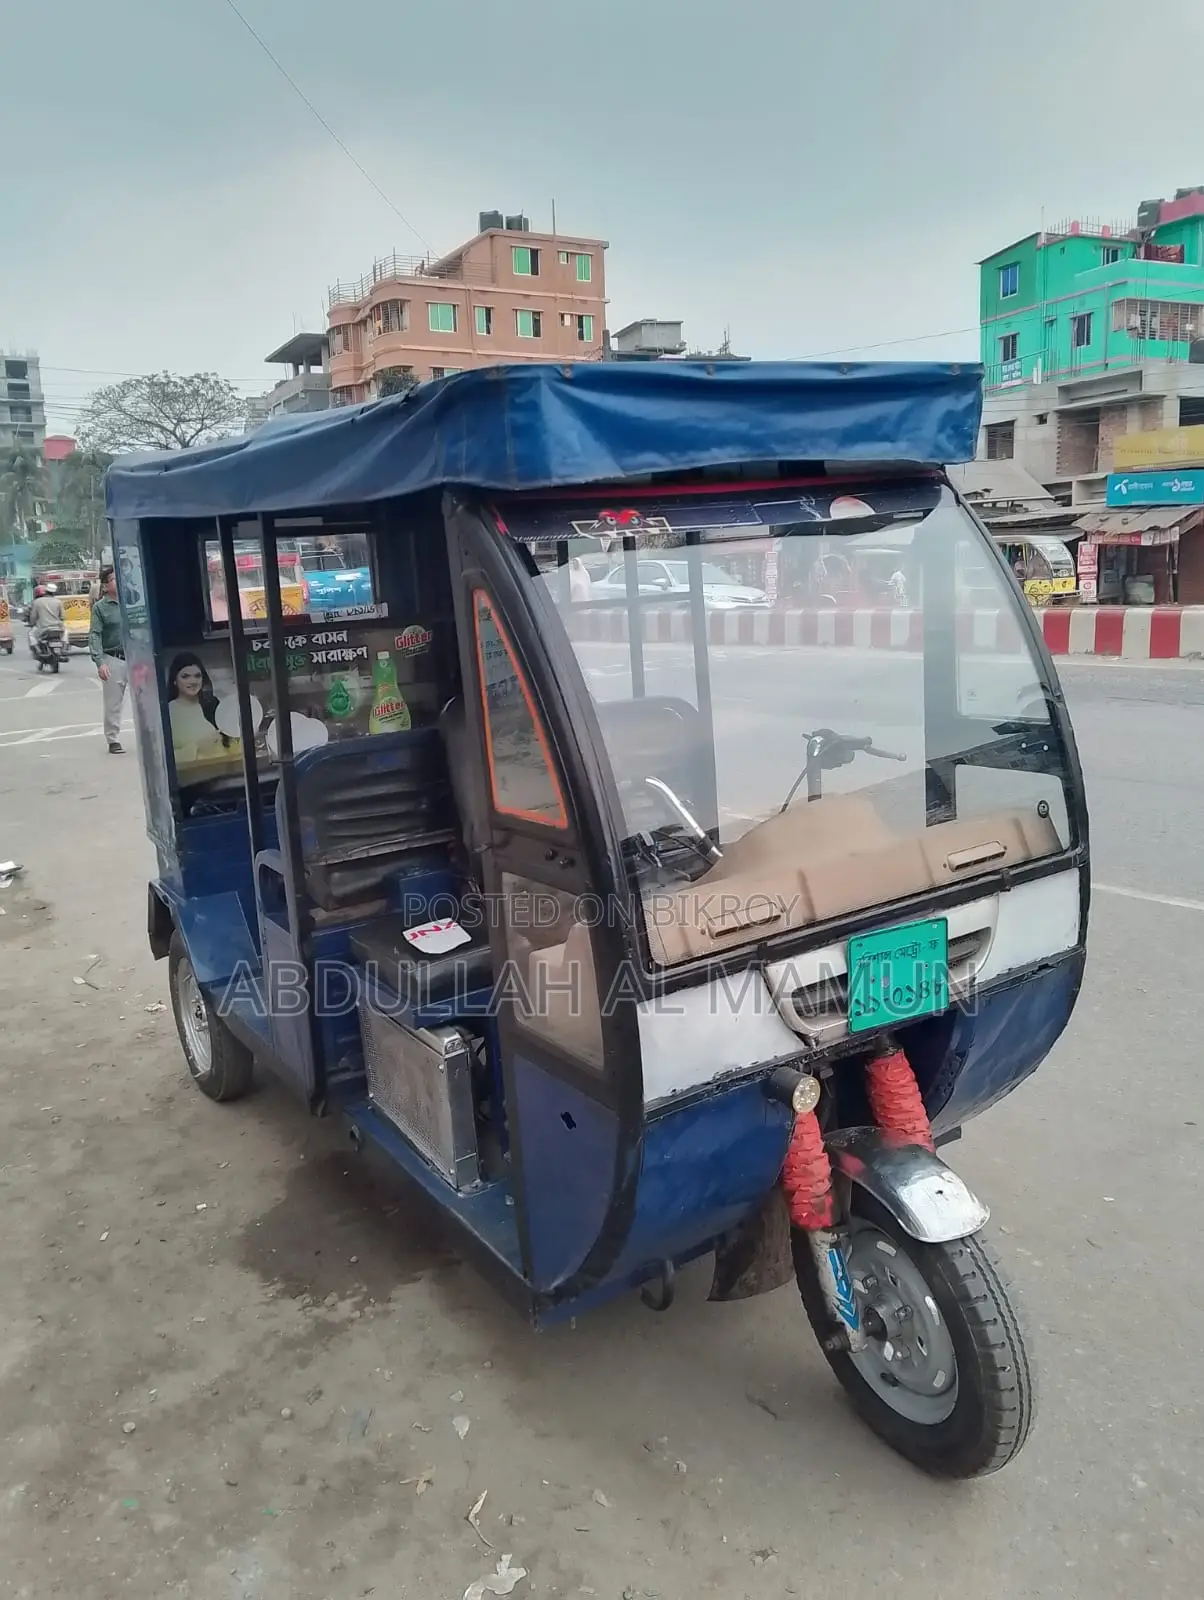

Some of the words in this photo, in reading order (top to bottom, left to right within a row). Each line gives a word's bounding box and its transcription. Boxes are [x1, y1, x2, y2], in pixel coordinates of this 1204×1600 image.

[311, 629, 349, 646] বাসন
[394, 631, 433, 650] Glitter
[310, 645, 369, 665] সারাক্ষণ
[374, 701, 407, 717] Glitter
[856, 952, 892, 968] বরিশাল
